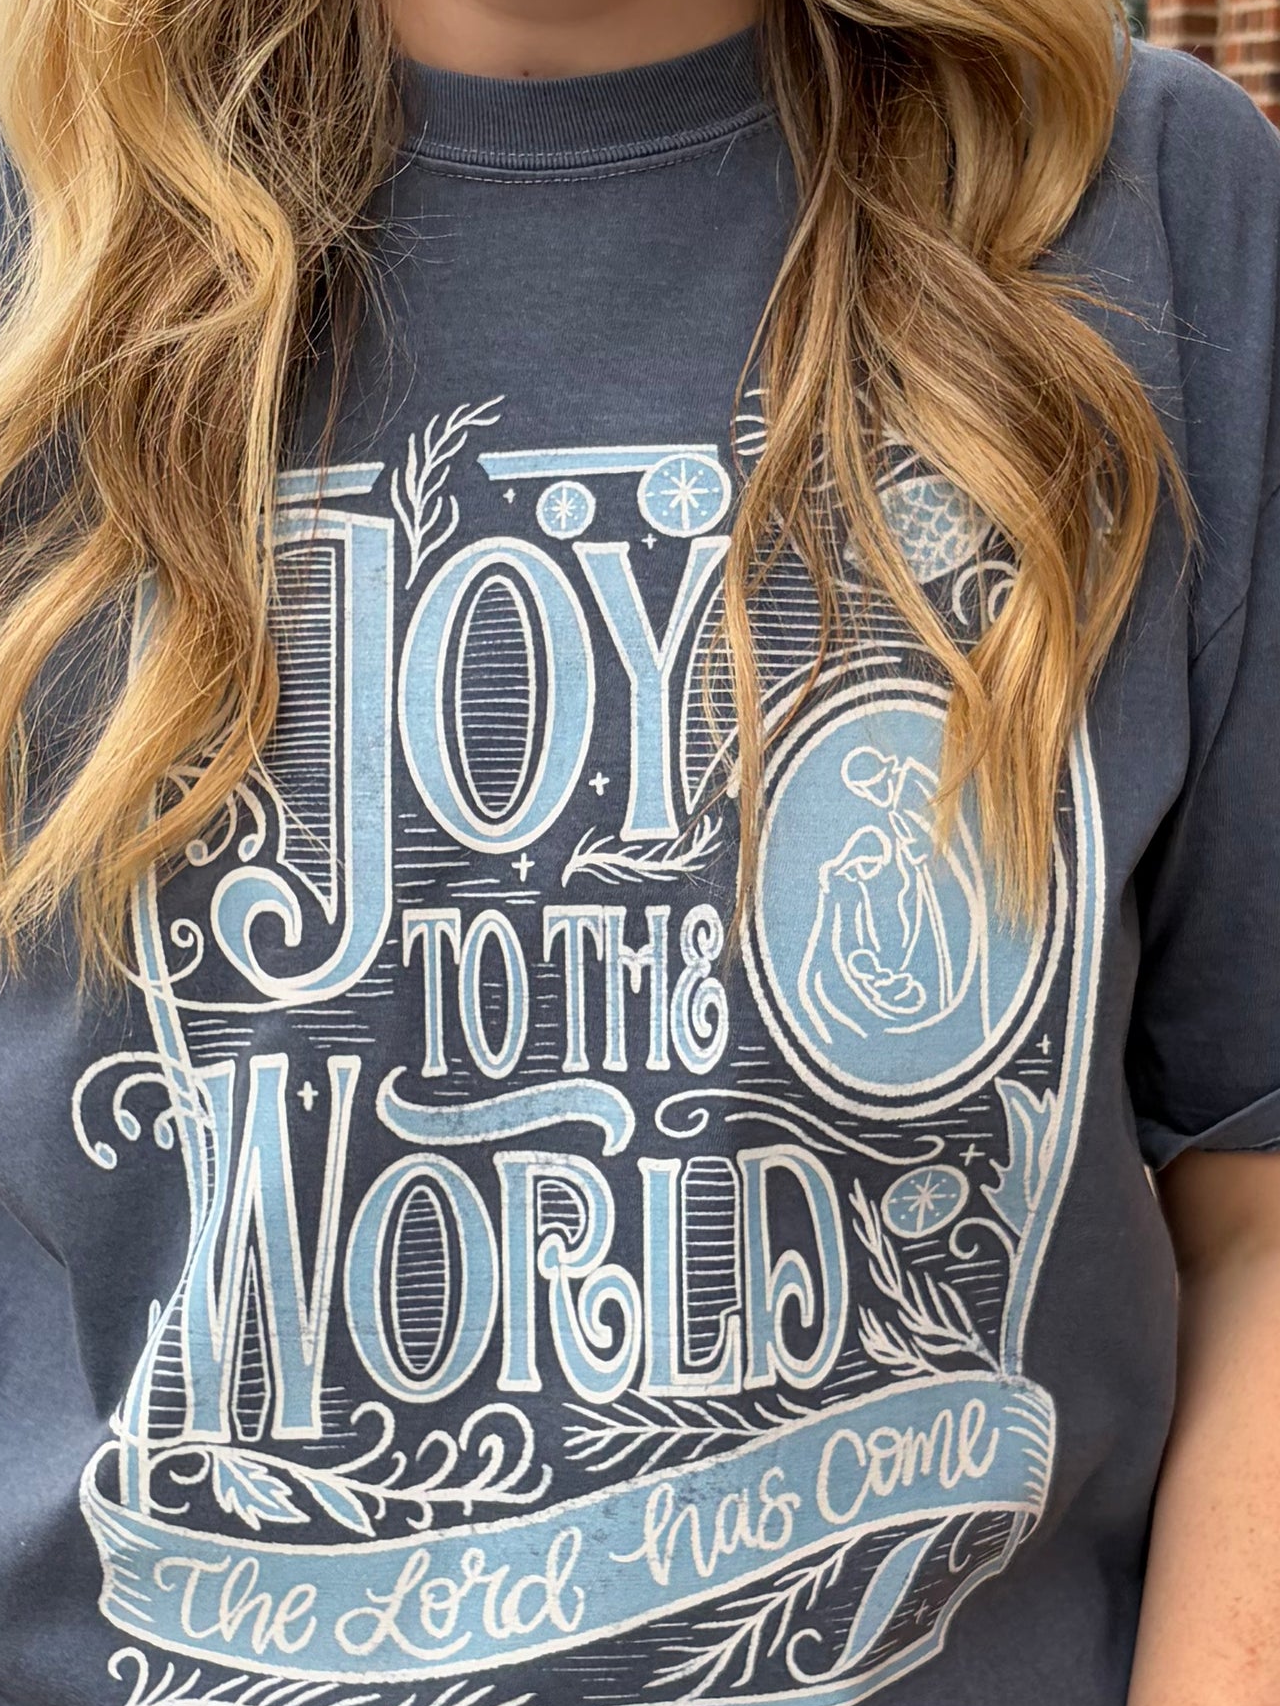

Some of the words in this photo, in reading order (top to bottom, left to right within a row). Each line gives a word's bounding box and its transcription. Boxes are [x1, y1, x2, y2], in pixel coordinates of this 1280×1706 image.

[402, 908, 529, 1079] TO
[543, 903, 729, 1076] THE
[183, 1051, 850, 1443] WORLD
[153, 1555, 317, 1656] The
[335, 1525, 587, 1661] Lord
